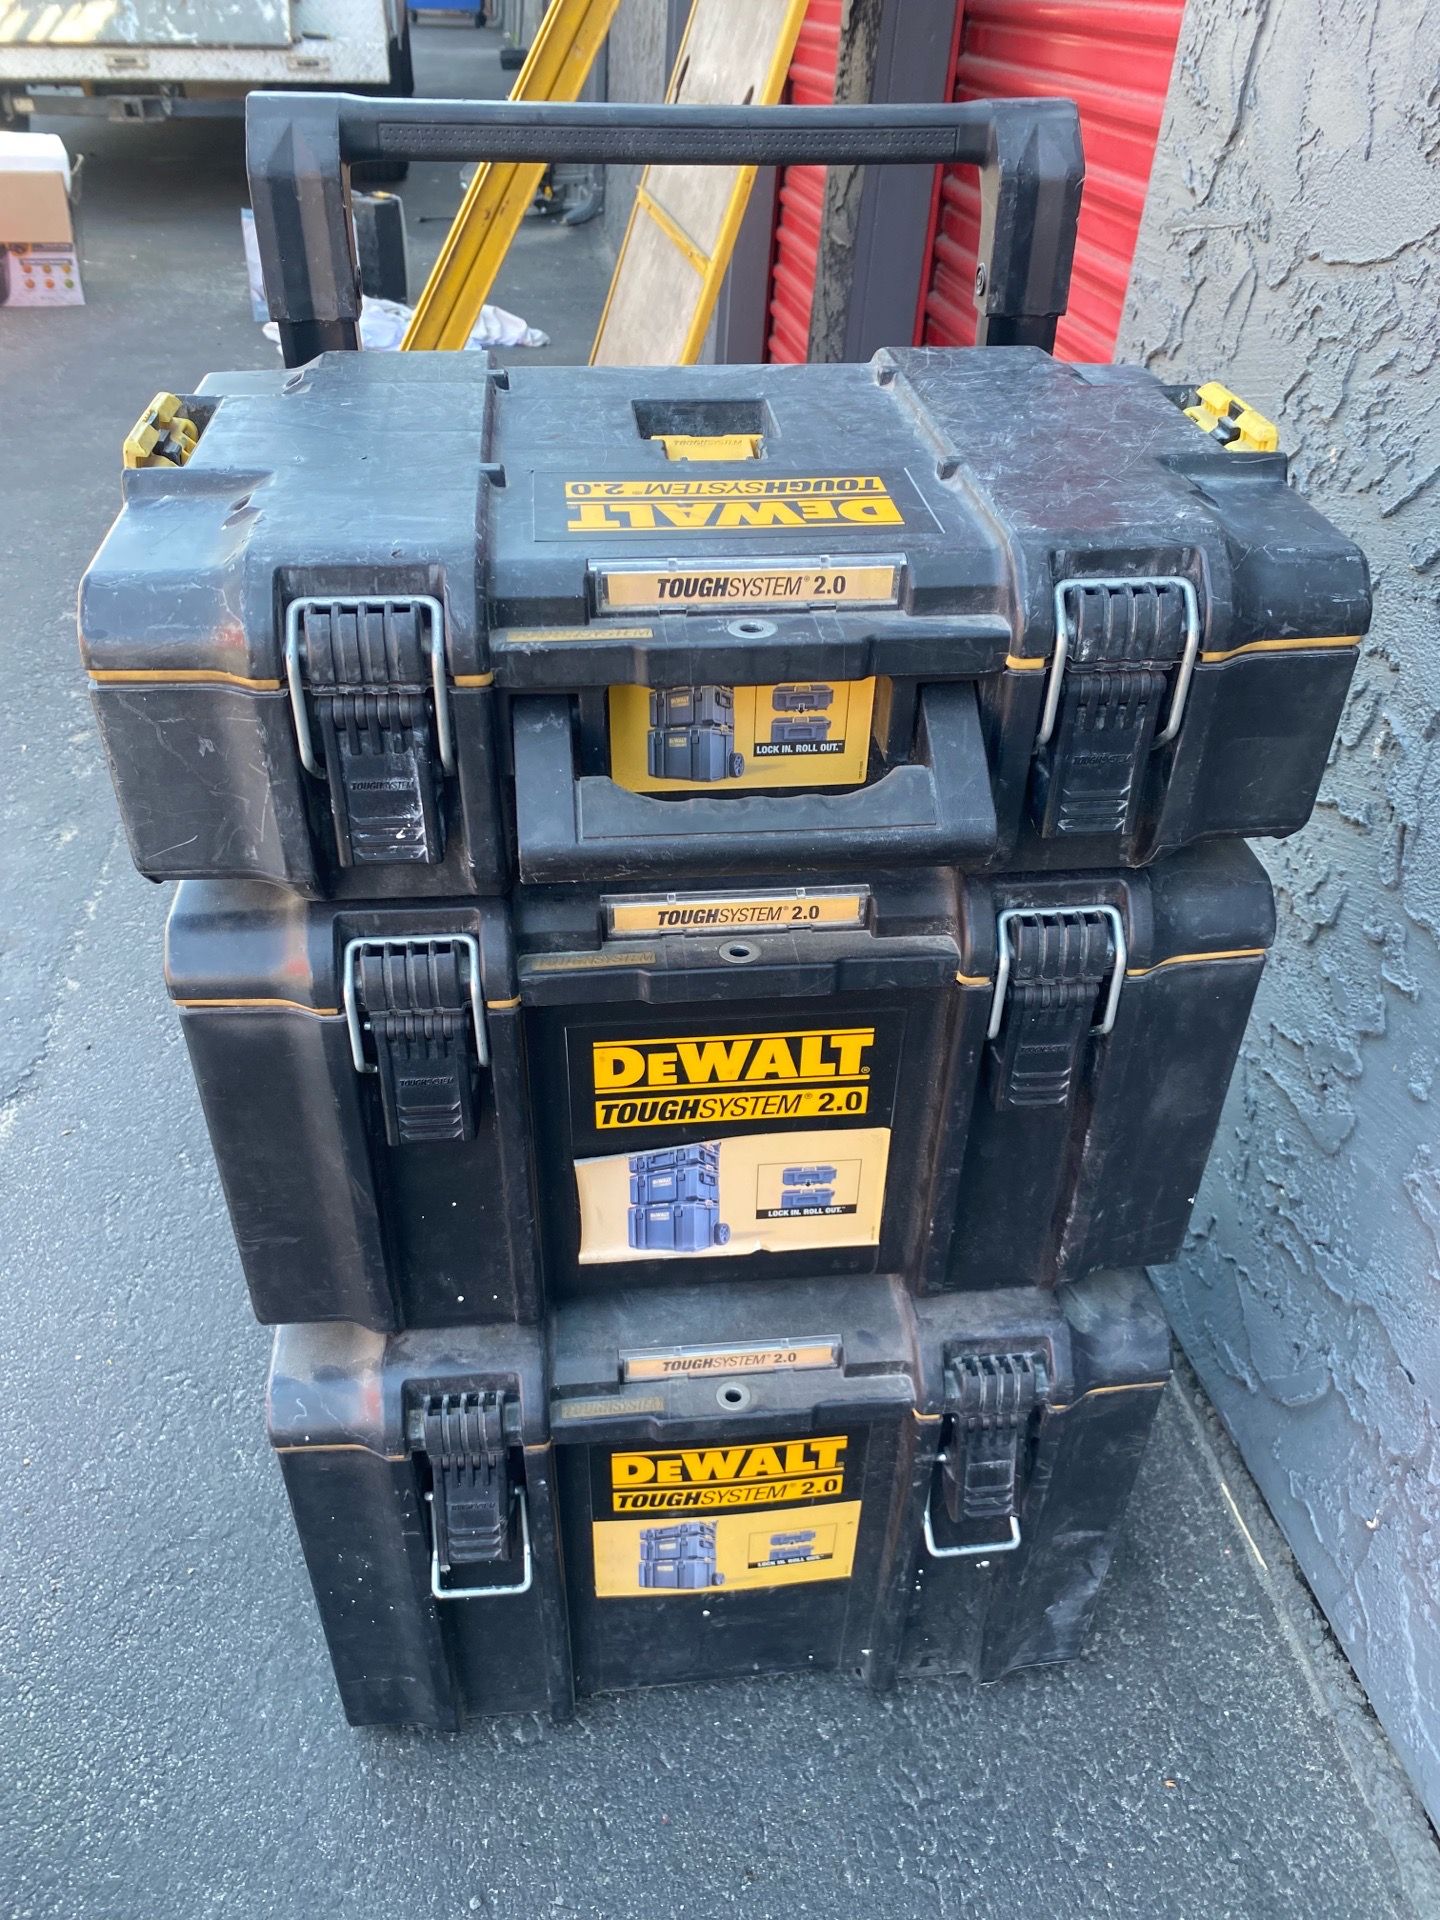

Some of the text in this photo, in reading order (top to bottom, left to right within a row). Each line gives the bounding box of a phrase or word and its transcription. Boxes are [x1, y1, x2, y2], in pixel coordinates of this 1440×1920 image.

[571, 483, 624, 496] 2.0
[814, 575, 846, 595] 2.0
[756, 745, 779, 754] LOCK
[781, 744, 793, 753] IN.
[796, 743, 818, 752] ROLL
[792, 905, 819, 920] 2.0
[818, 1091, 862, 1112] 2.0
[768, 1209, 789, 1217] LOCK
[791, 1208, 802, 1216] IN.
[804, 1207, 823, 1215] ROLL
[774, 1352, 797, 1364] 2.0
[801, 1479, 838, 1495] 2.0
